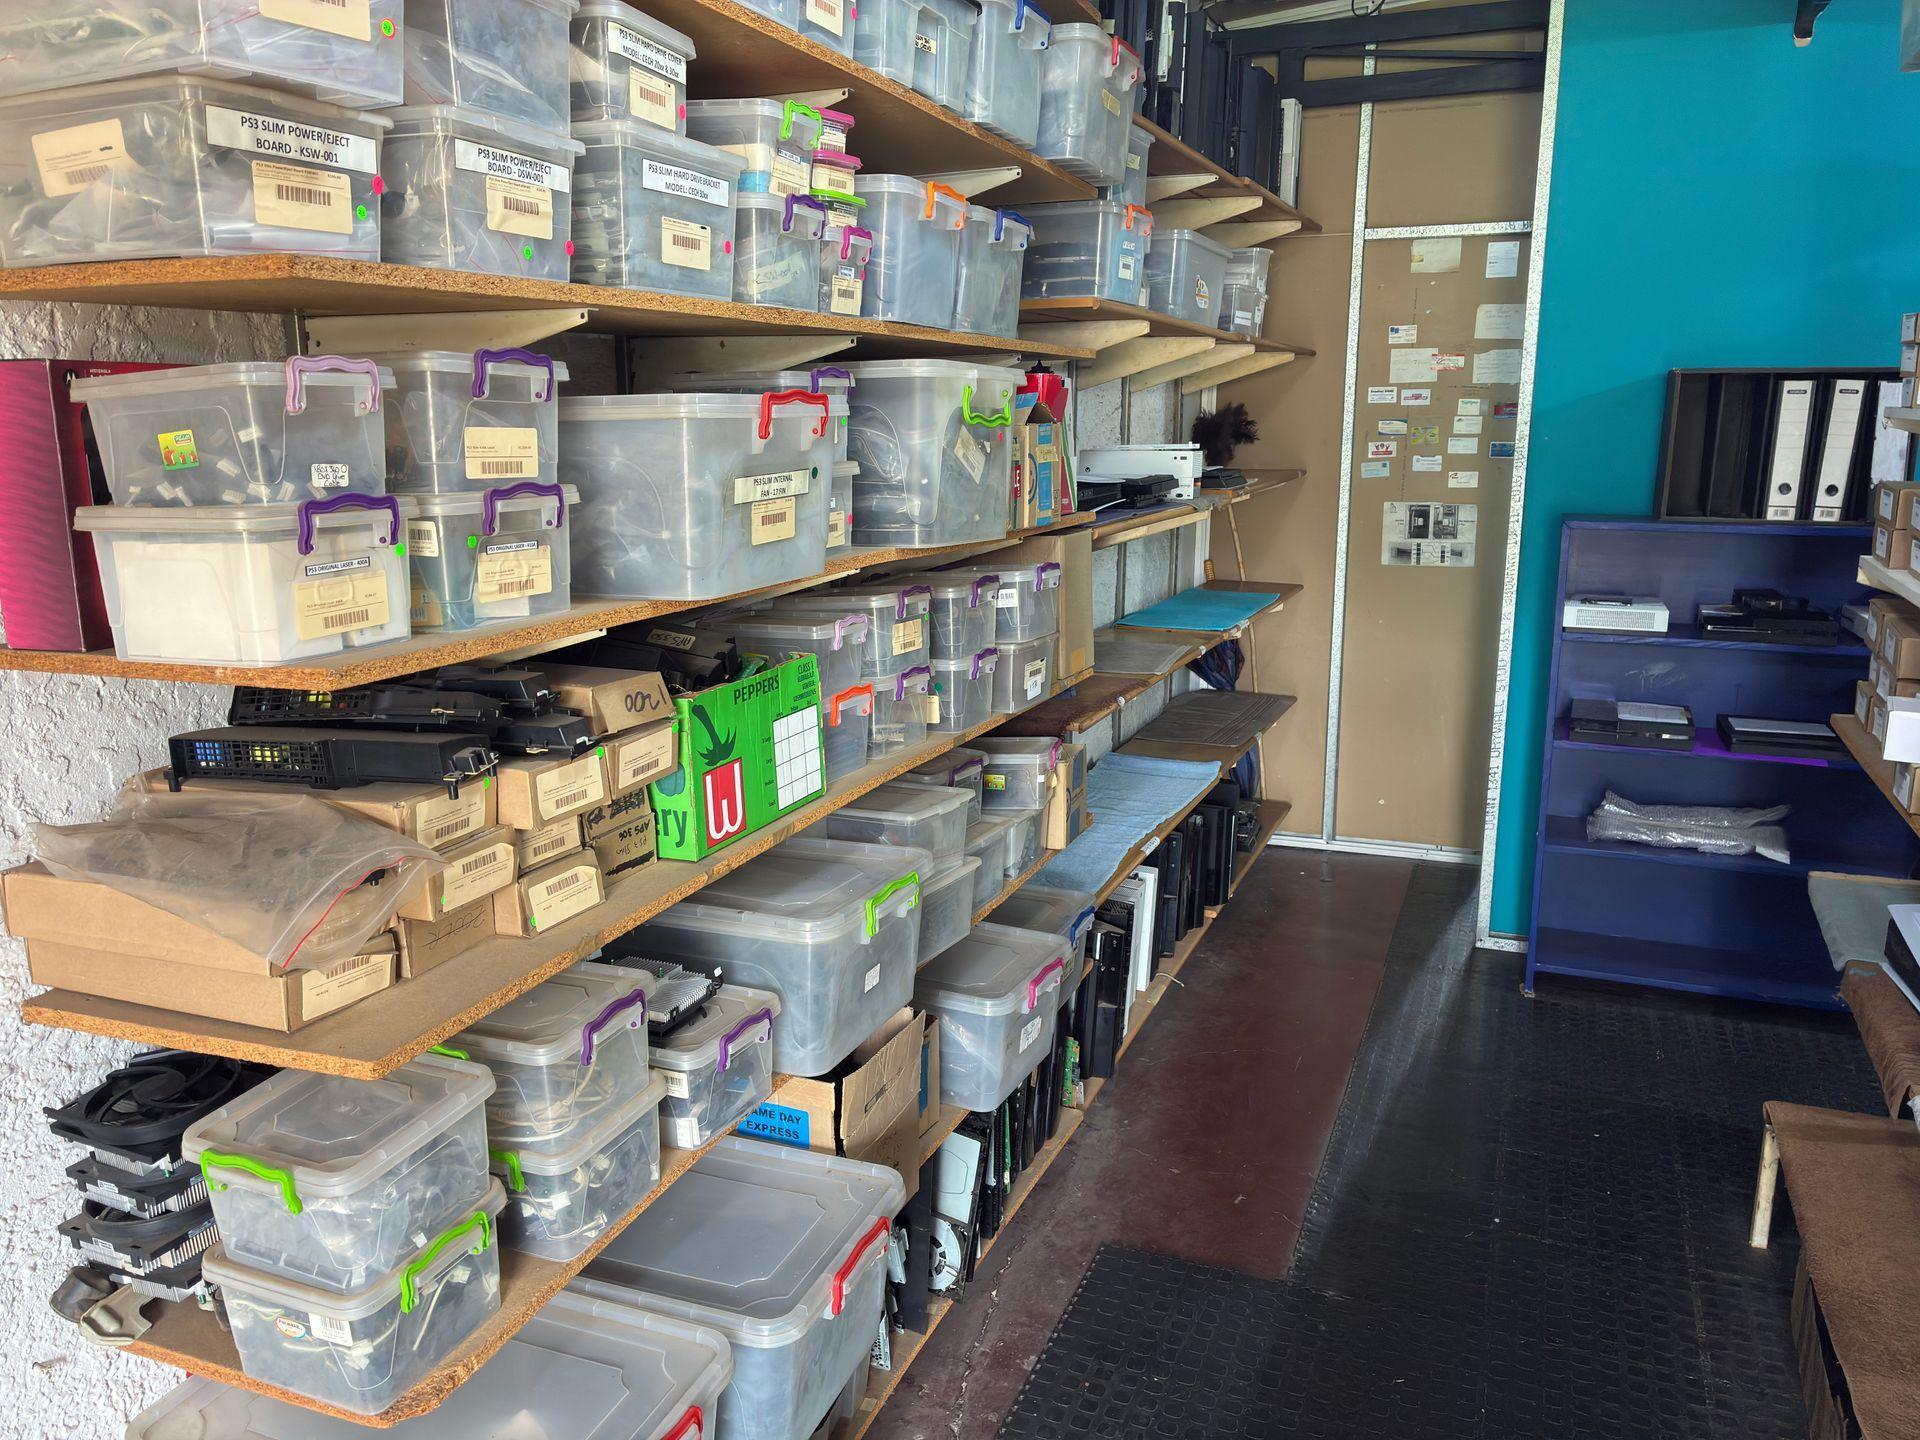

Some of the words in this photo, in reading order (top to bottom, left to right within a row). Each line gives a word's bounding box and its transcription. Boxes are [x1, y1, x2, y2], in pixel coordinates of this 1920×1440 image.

[619, 28, 628, 40] PS3
[629, 33, 640, 45] SLIM
[641, 38, 654, 52] HARD
[654, 44, 666, 59] DRIVE
[668, 51, 682, 66] COVER
[622, 45, 642, 60] MODEL:
[240, 116, 259, 130] PS3
[262, 120, 285, 134] SLIM
[288, 127, 350, 148] POWER/EJECT
[256, 138, 292, 154] BOARD
[300, 146, 339, 164] KSW-001
[478, 148, 490, 160] PS3
[492, 151, 508, 161] SLIM
[510, 155, 552, 175] POWER/EJECT
[488, 162, 512, 175] BOARD
[518, 168, 544, 184] DSW-001
[648, 164, 658, 174] PS3
[659, 166, 672, 177] SLIM
[674, 170, 689, 181] HARD
[690, 173, 703, 185] DRIVE
[703, 177, 720, 189] BRACKET
[665, 182, 688, 194] MODEL:
[754, 478, 762, 486] PS3
[762, 476, 772, 485] SLIM
[773, 474, 793, 484] INTERNAL
[317, 564, 339, 572] ORIGINAL
[734, 674, 780, 705] PEPPERS
[619, 828, 632, 841] 306
[635, 819, 650, 835] APS
[752, 1108, 776, 1119] AME
[780, 1112, 802, 1125] DAY
[746, 1120, 800, 1140] EXPRESS
